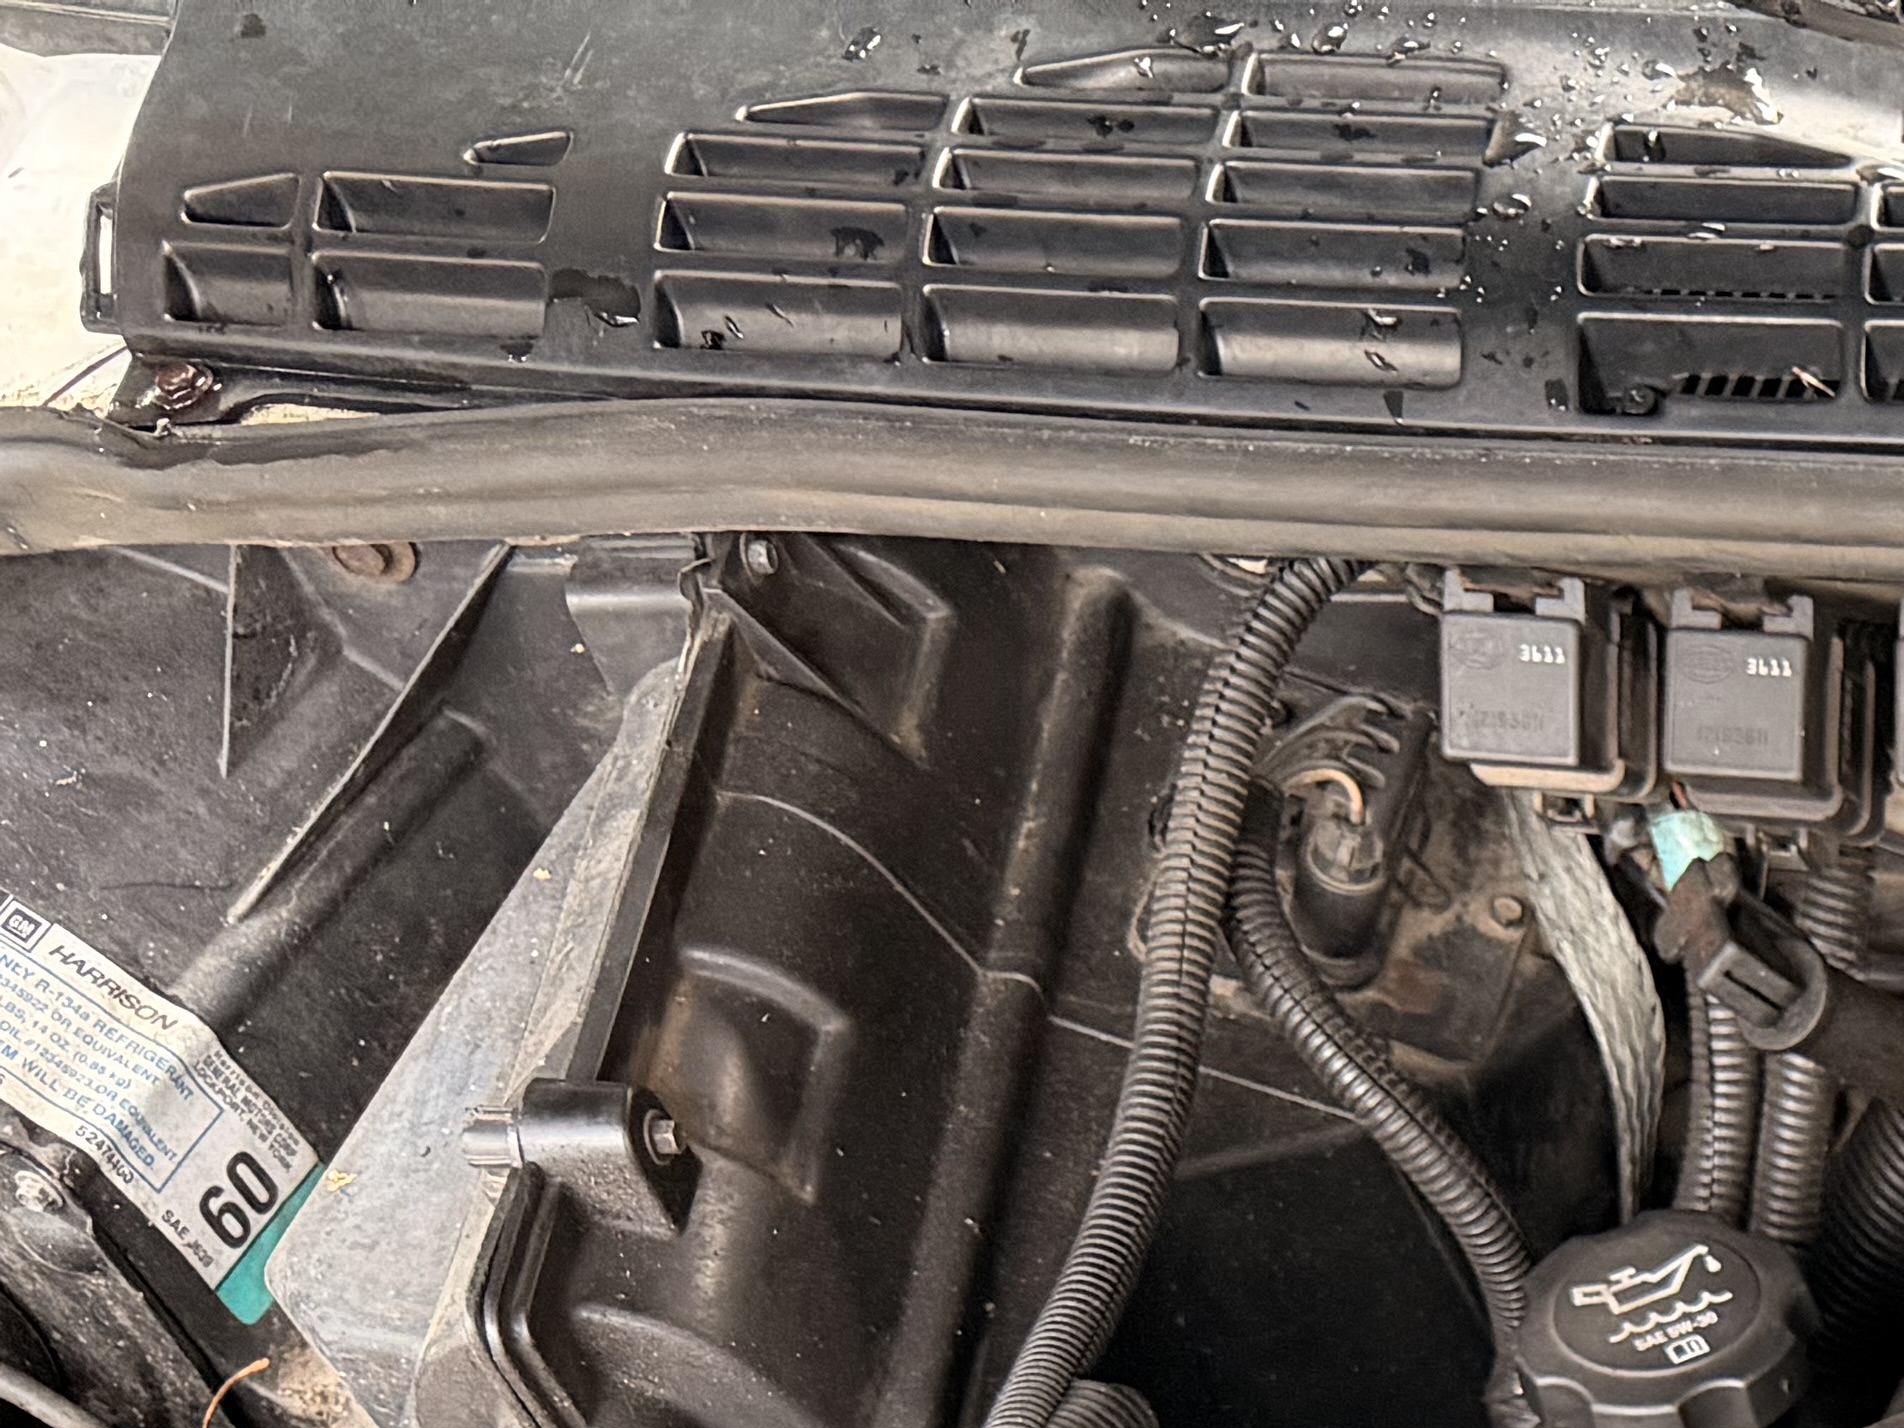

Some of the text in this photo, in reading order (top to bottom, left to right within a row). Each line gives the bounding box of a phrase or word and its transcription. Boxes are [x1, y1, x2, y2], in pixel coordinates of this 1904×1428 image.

[9, 911, 35, 939] GM
[48, 945, 179, 1031] HARRISON
[51, 1011, 72, 1031] OR
[74, 1028, 160, 1085] EQUIVALENT
[93, 1018, 194, 1100] REFRIGERANT
[22, 1057, 58, 1092] WILL
[63, 1087, 87, 1108] BE
[161, 1209, 190, 1240] SAE
[199, 1151, 279, 1249] 60
[1635, 1328, 1668, 1352] SAE
